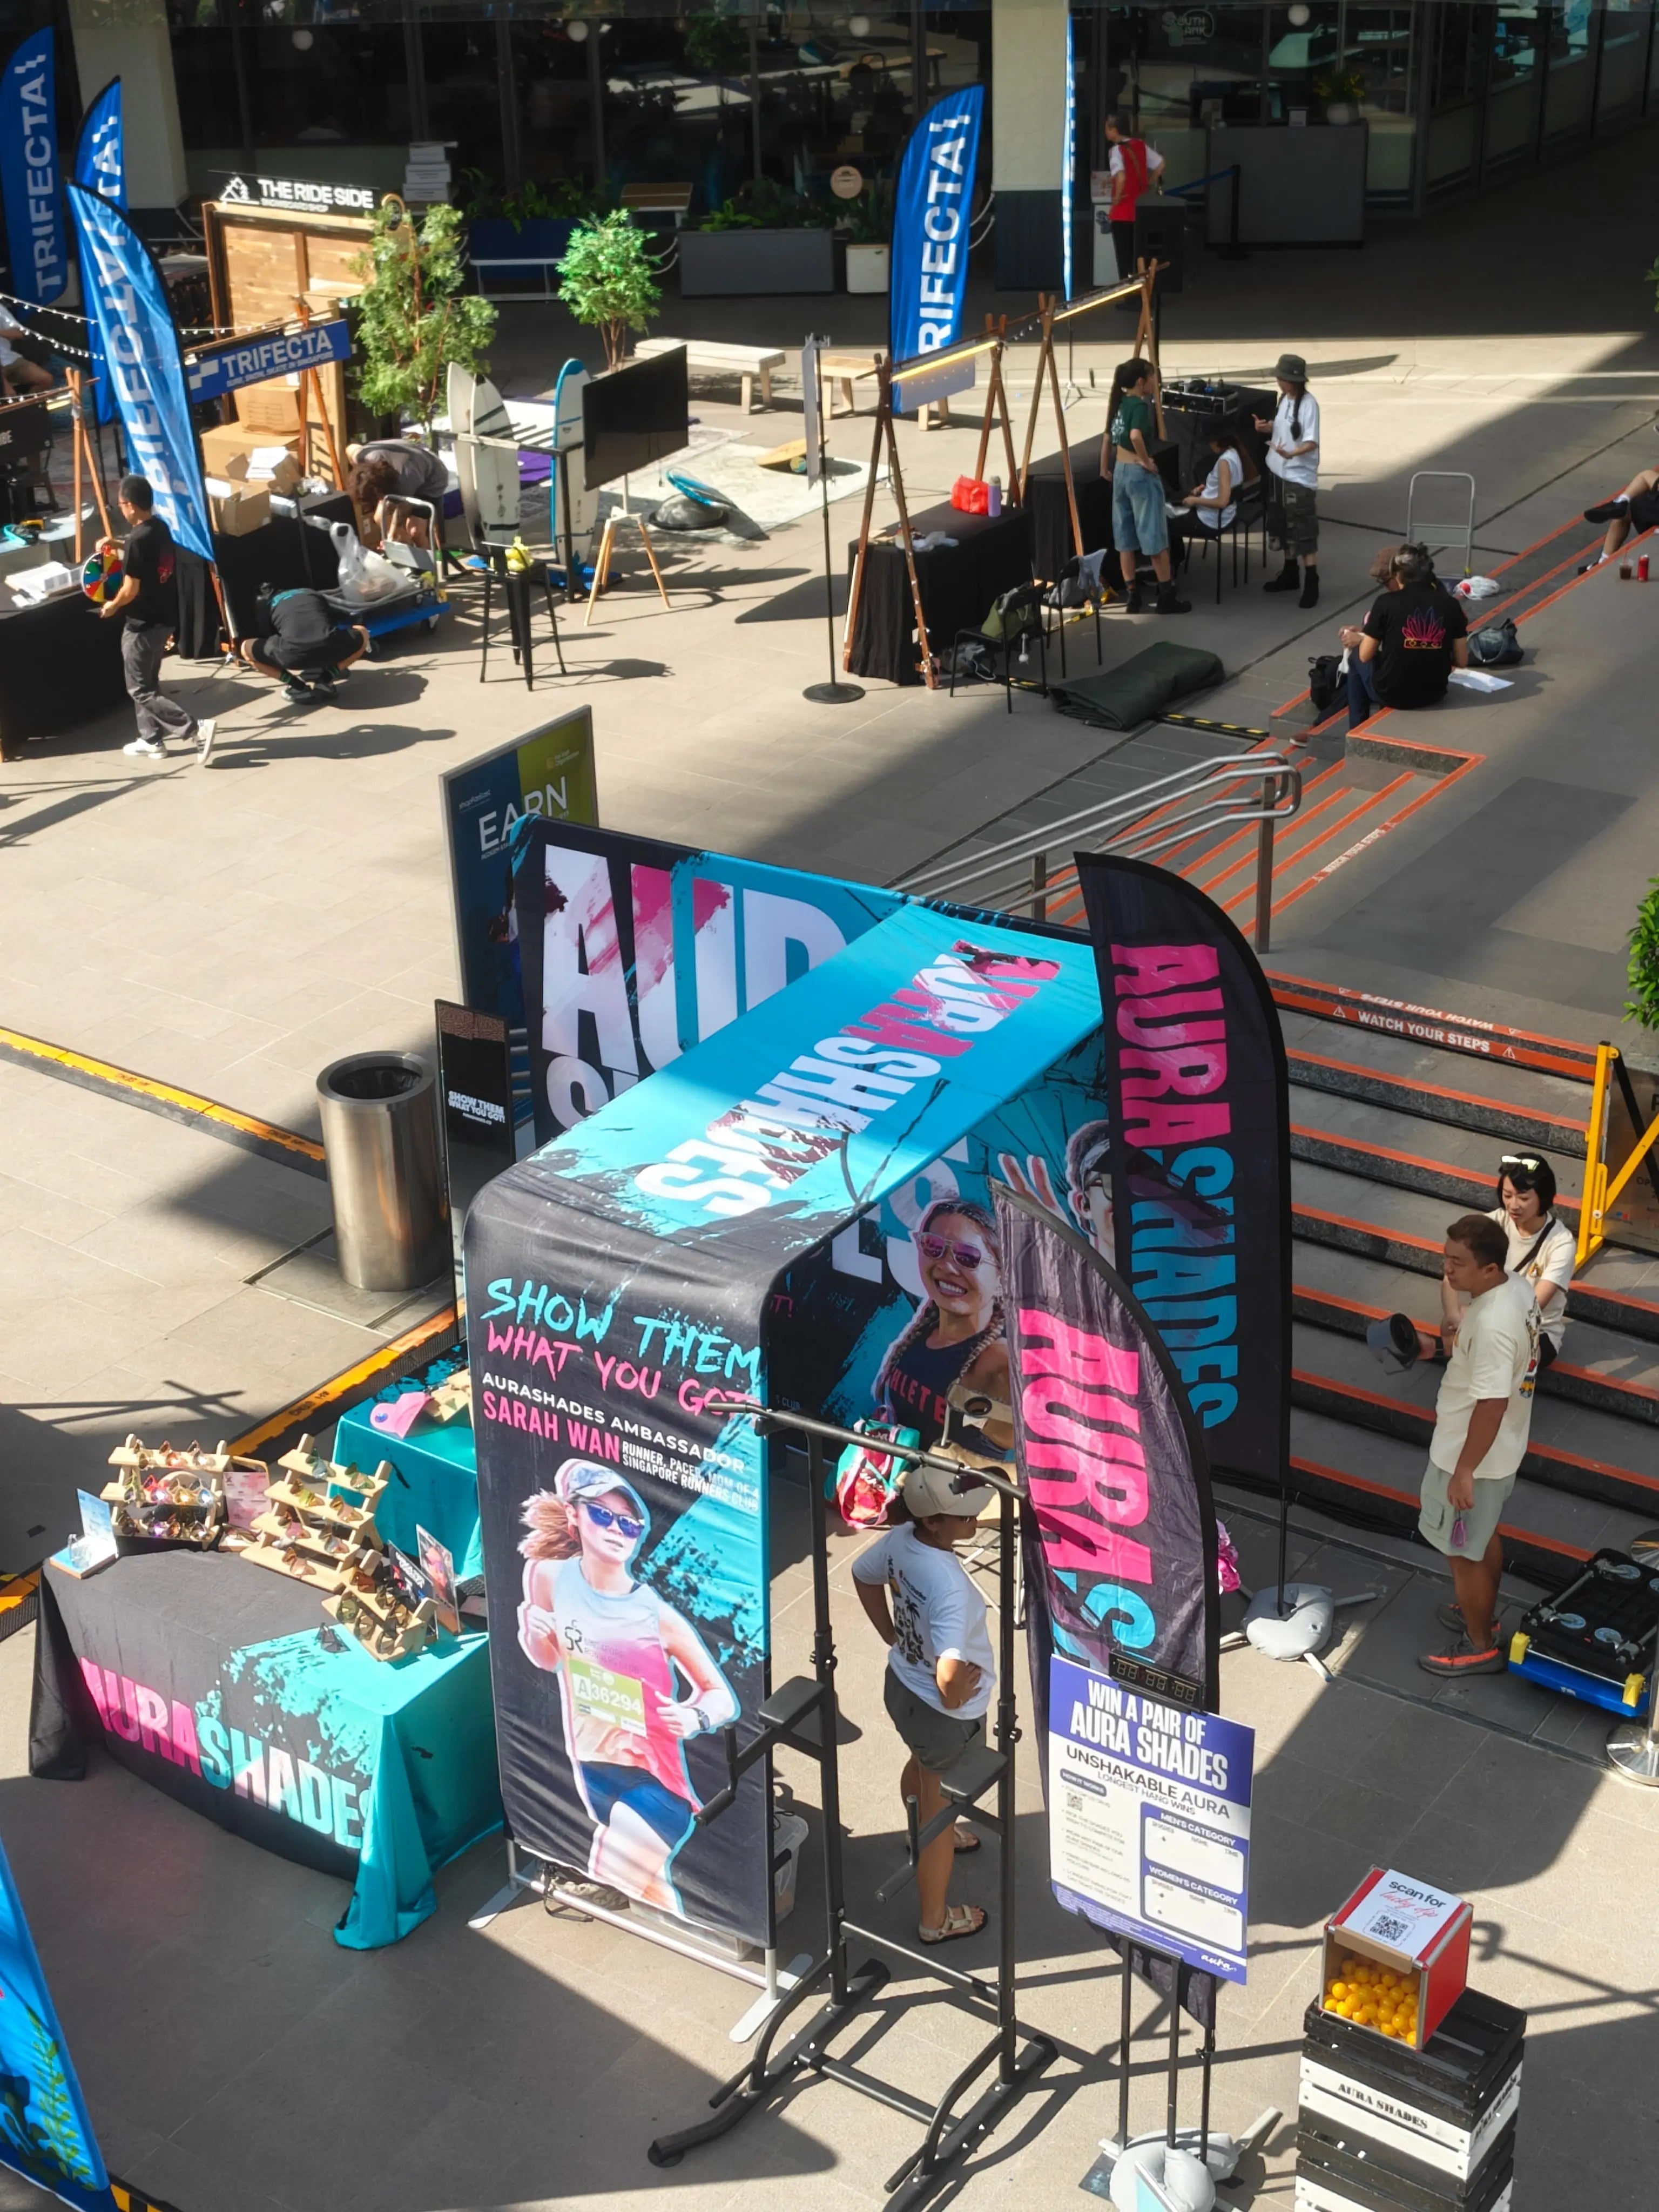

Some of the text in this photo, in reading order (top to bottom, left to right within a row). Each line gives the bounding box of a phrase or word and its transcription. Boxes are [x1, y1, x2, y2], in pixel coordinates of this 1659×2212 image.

[21, 72, 62, 298] TRIFECTA
[257, 179, 374, 209] THE RIDE SIDE
[918, 137, 966, 355] RIFECTA
[222, 329, 333, 377] TRIFECTA
[479, 776, 567, 852] EARN
[1357, 1010, 1490, 1053] WATCH YOUR STEPS
[448, 1090, 504, 1116] SHOW THEM
[470, 1105, 487, 1117] YOU
[480, 1278, 761, 1380] SHOW THEM
[487, 1319, 584, 1382] WHAT
[594, 1350, 662, 1399] YOU
[482, 1372, 746, 1474] AURASHADES AMBASSADOR
[482, 1391, 621, 1464] SARAH WAN
[622, 1441, 666, 1468] RUNNER,
[622, 1453, 678, 1485] SINGAPORE
[680, 1473, 729, 1502] RUNNERS
[1088, 1679, 1206, 1745] WIN A PAIR OF
[81, 1656, 370, 1849] URASHADE
[1069, 1700, 1229, 1791] AURA SHADES
[1066, 1744, 1178, 1800] UNSHAKABLE
[1181, 1791, 1231, 1819] AURA
[1097, 1770, 1139, 1796] LONGEST
[1170, 1797, 1196, 1816] WINS
[1161, 1812, 1237, 1847] MEN'S CATEGORY
[1149, 1864, 1190, 1887] WOMEN'S
[1190, 1881, 1238, 1906] CATEGORY
[1388, 1881, 1447, 1908] scan for
[1338, 2083, 1428, 2130] AURA SHADES
